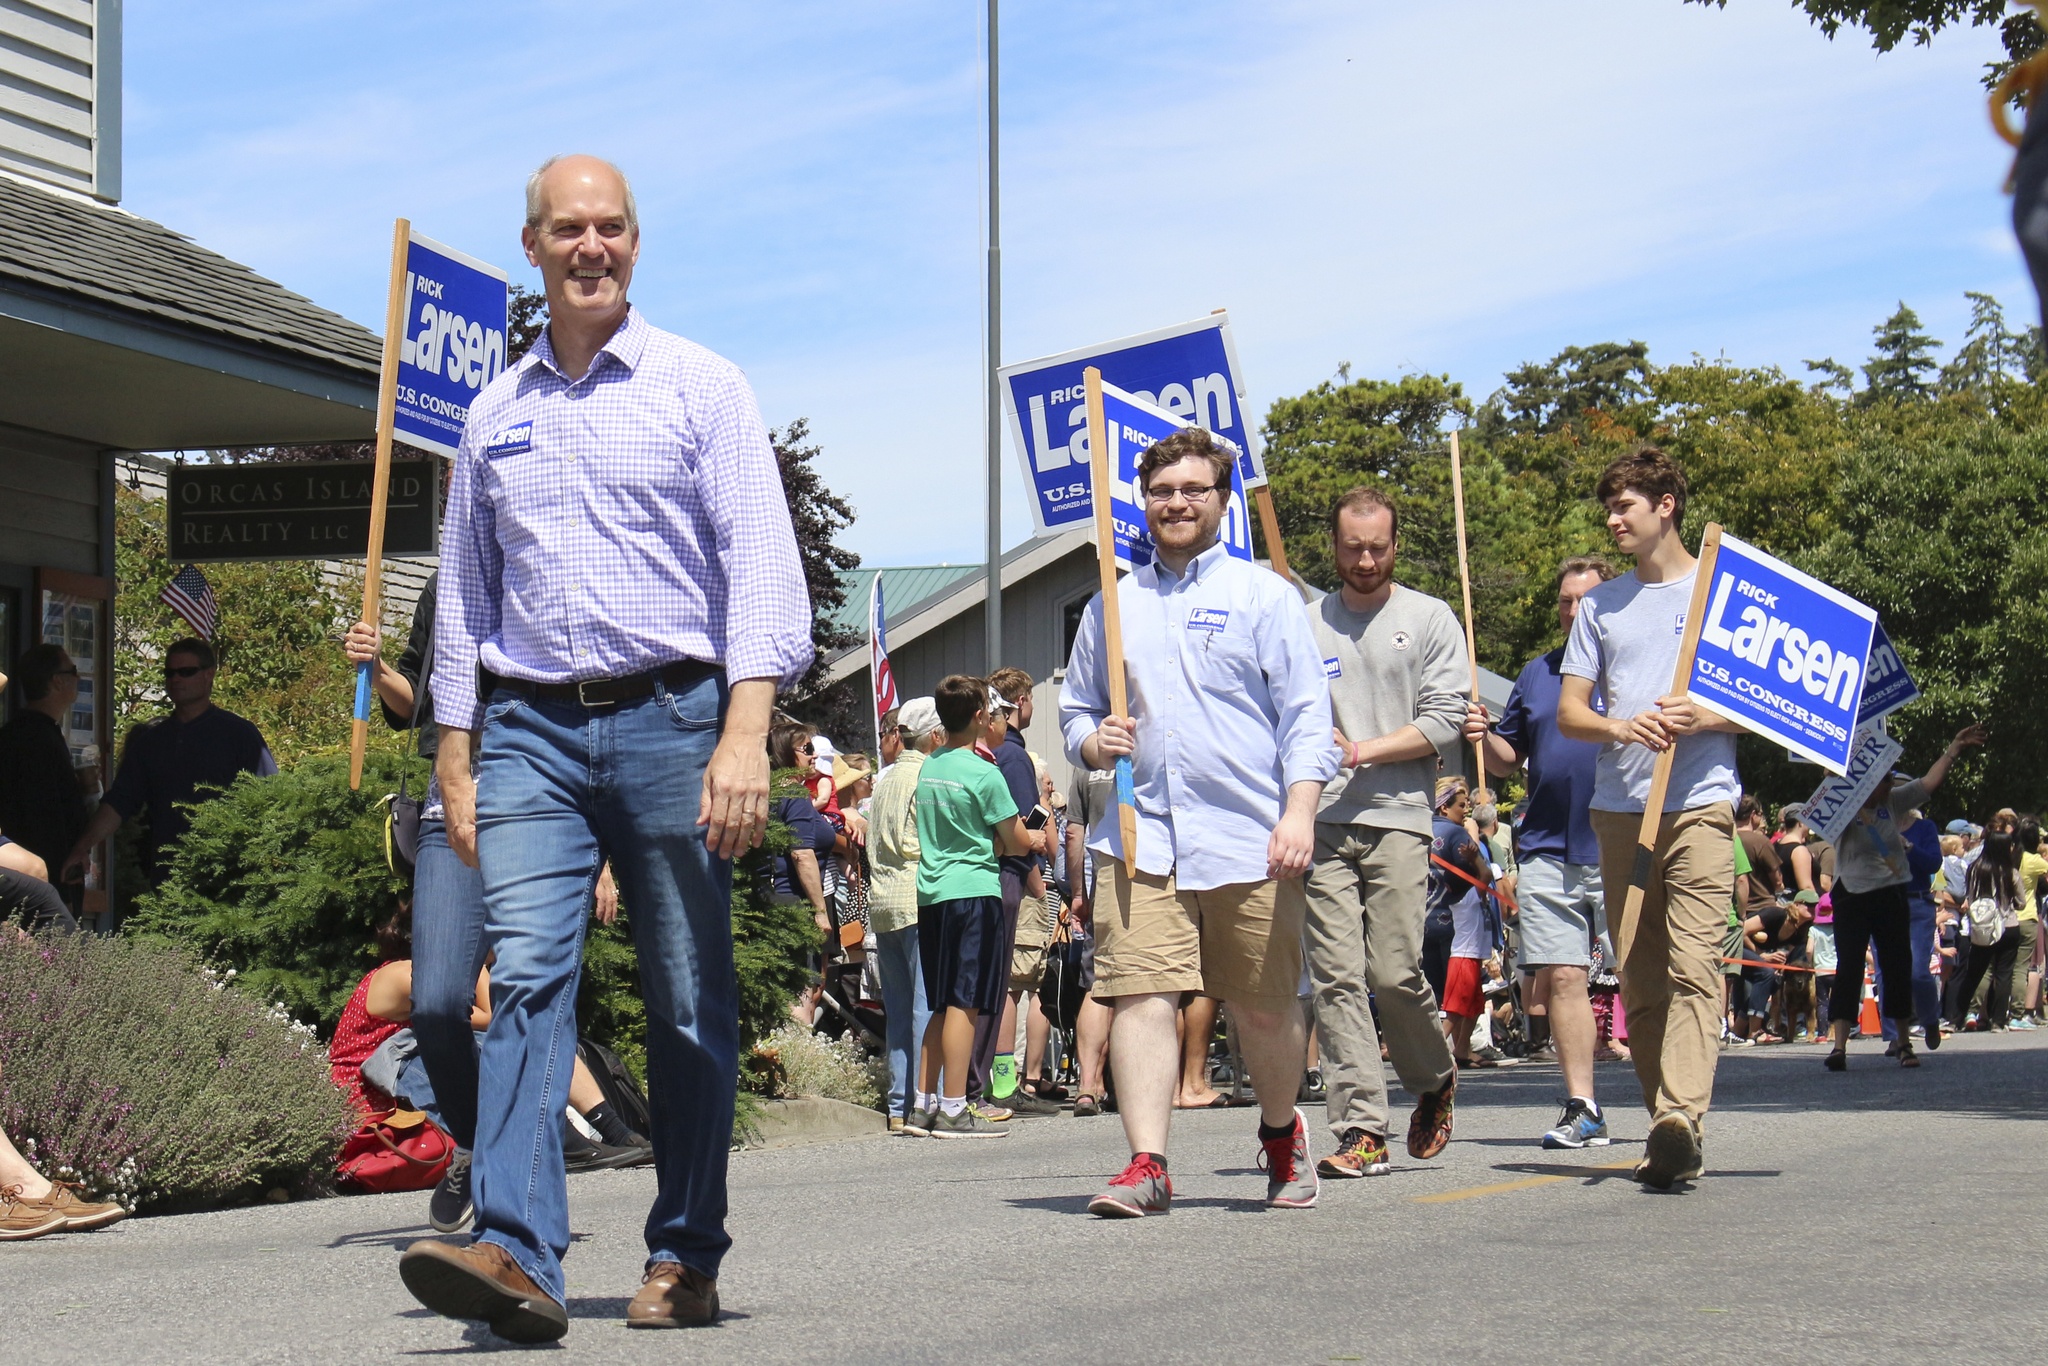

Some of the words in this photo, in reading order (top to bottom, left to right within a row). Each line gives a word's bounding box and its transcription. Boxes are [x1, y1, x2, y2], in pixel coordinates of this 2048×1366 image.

[416, 274, 444, 300] RICK
[399, 270, 503, 391] Larsen
[396, 384, 418, 406] U.S.
[1050, 384, 1085, 406] RIC
[1028, 371, 1234, 473] Laen
[488, 425, 531, 446] Larsen
[1123, 425, 1159, 448] RICK
[181, 481, 284, 504] ORCAS
[1043, 482, 1091, 502] U.S.
[1052, 501, 1081, 512] AUTHORIZED
[183, 522, 292, 544] REALTY
[1112, 516, 1145, 542] U.S.
[1736, 578, 1780, 610] RICK
[1190, 609, 1227, 626] Larsen
[1701, 571, 1861, 712] Larsen
[1696, 675, 1720, 690] AUTHORIZED
[1719, 686, 1728, 694] AND
[1727, 690, 1737, 698] PAID
[1860, 677, 1909, 709] NGRESS
[1696, 658, 1733, 686] U.S.
[1735, 677, 1848, 742] CONGRESS
[1850, 727, 1873, 758] EVIN
[1808, 736, 1888, 830] RANKER
[1801, 785, 1829, 819] Re-Elect
